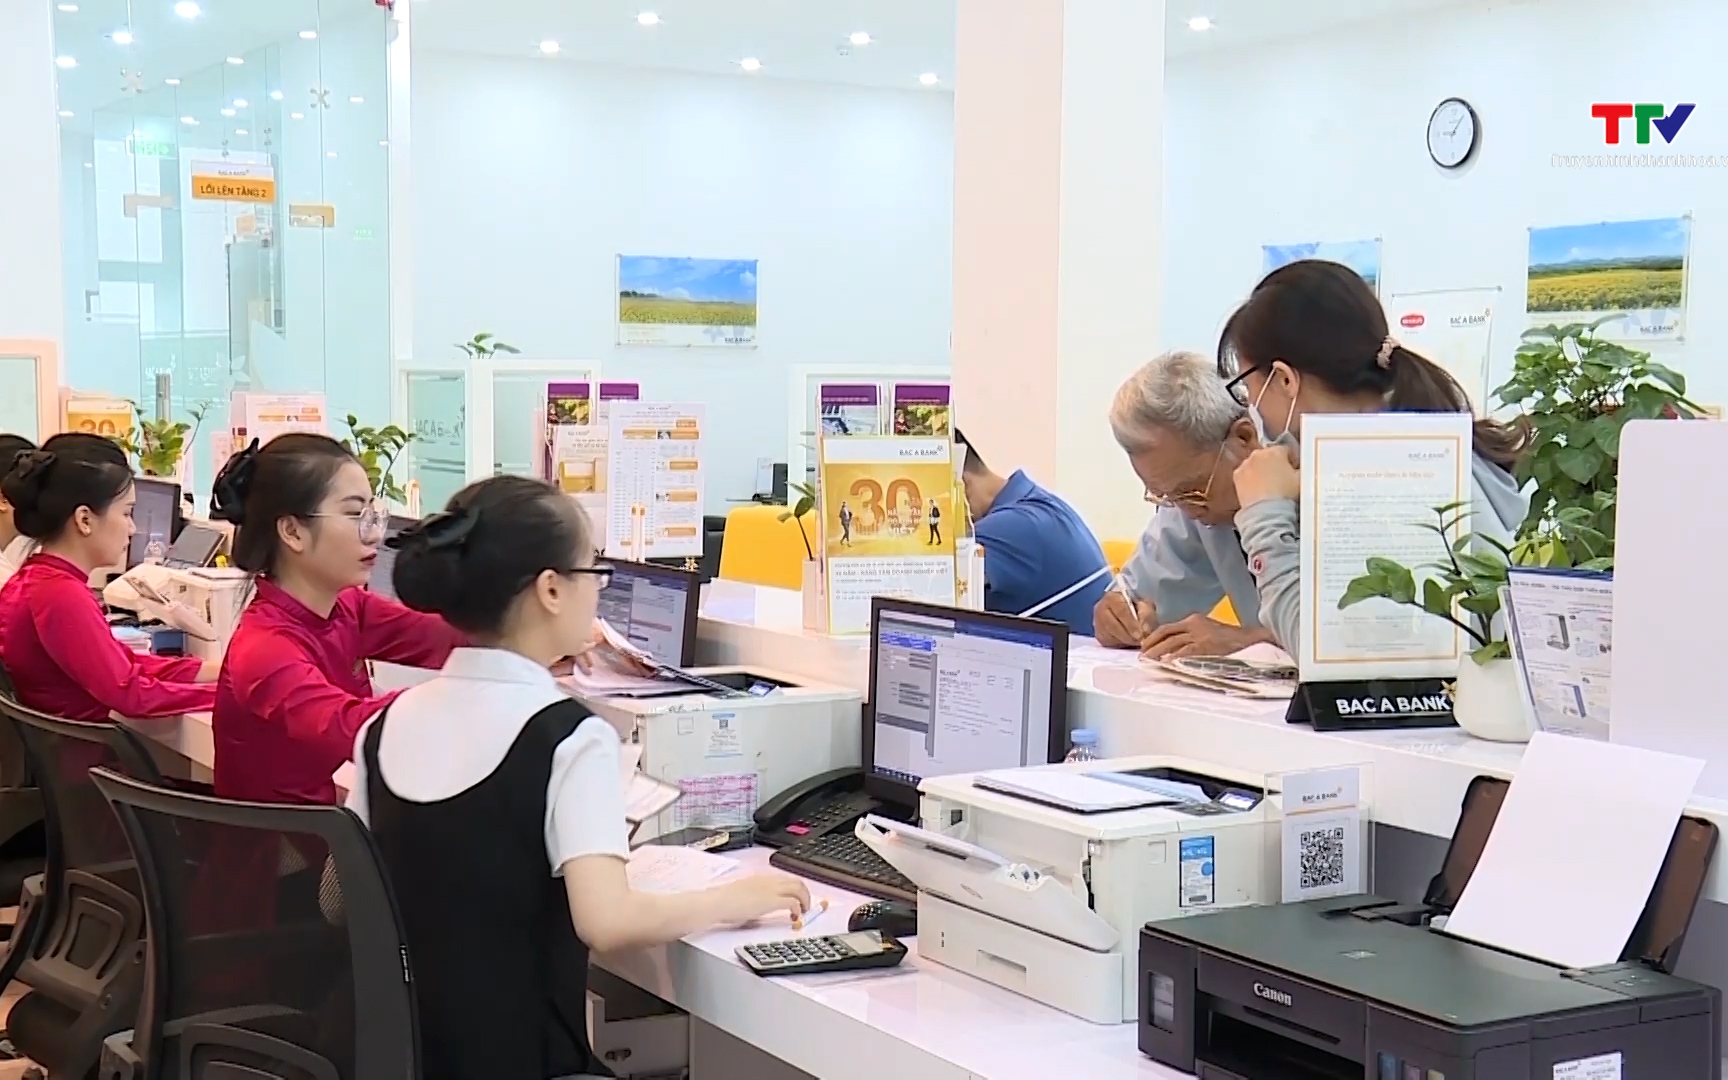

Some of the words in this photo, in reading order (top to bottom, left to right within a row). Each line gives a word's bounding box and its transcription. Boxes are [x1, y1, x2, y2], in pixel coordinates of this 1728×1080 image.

[261, 189, 267, 198] 2
[849, 478, 923, 536] 30
[1336, 697, 1376, 714] BAC
[1380, 697, 1395, 713] A
[1396, 694, 1452, 712] BANK
[1253, 982, 1292, 1006] Canon
